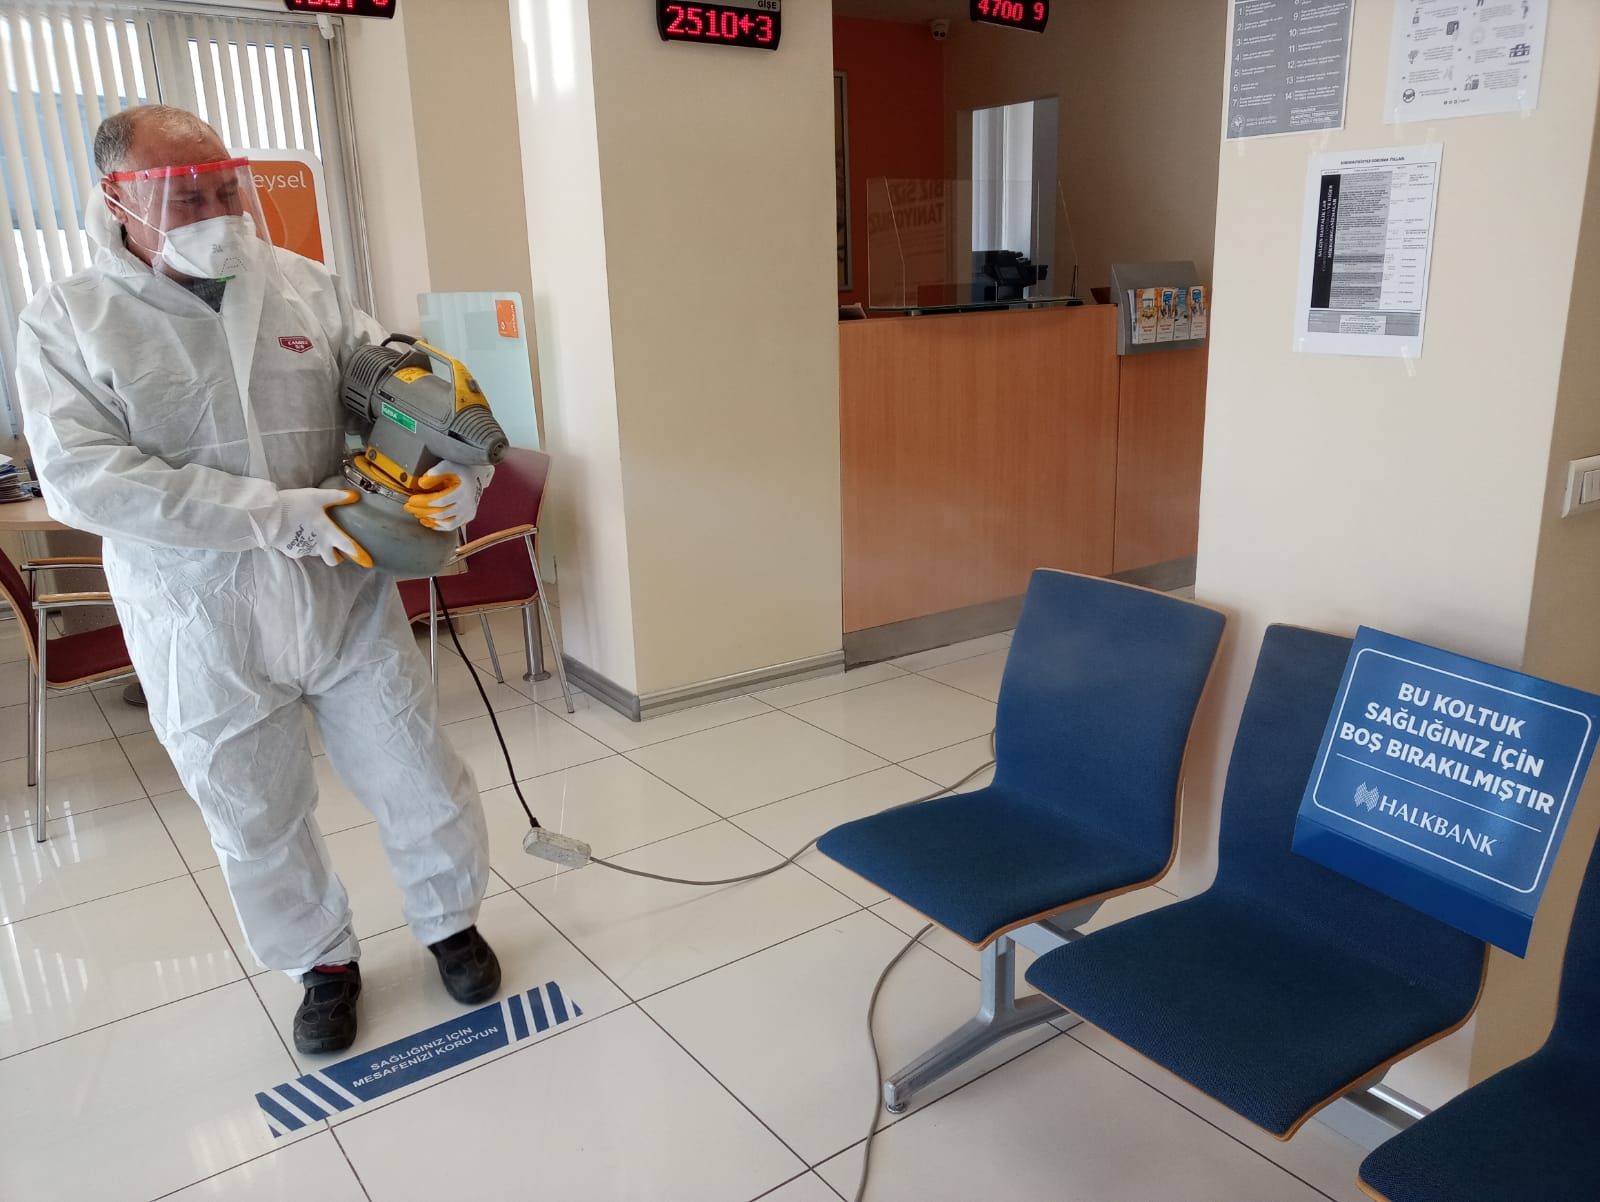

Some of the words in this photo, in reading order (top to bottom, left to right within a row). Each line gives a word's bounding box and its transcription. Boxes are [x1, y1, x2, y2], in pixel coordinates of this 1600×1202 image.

[978, 0, 1024, 21] 4700
[1033, 2, 1044, 20] 9
[253, 170, 307, 192] eysel
[1364, 702, 1490, 758] SAĞLIĞINIZ
[1492, 740, 1545, 778] İÇİN
[1398, 682, 1430, 707] BU
[1432, 693, 1527, 739] KOLTUK
[1339, 722, 1384, 753] BOŞ
[1386, 738, 1555, 815] BIRAKILMIŞTIR
[1378, 795, 1498, 857] HALKBANK
[352, 1052, 433, 1088] MESAFENİZİ
[435, 1026, 499, 1057] KORUYUN
[370, 1037, 446, 1071] SAĞLIĞINIZ
[447, 1027, 473, 1041] İÇİN
